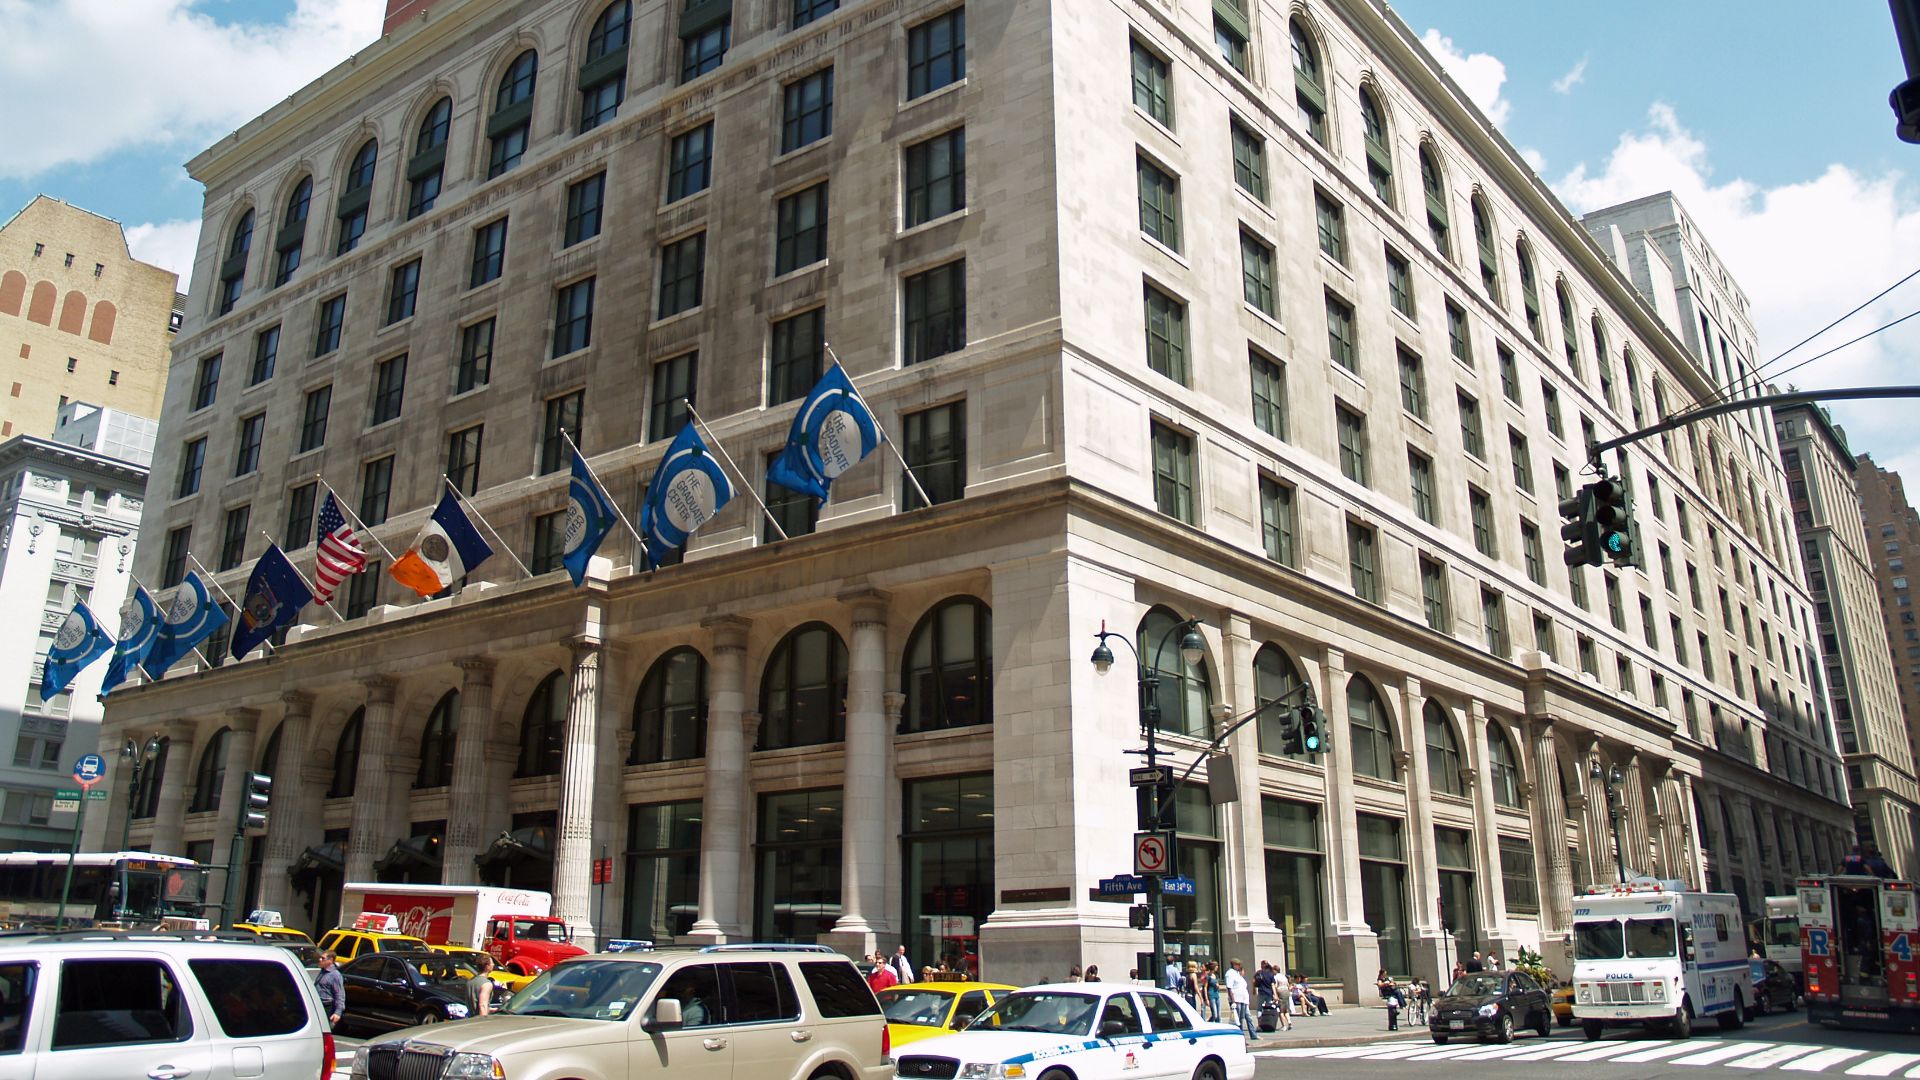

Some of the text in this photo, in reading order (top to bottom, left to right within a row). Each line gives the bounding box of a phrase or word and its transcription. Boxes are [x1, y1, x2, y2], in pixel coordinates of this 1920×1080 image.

[833, 413, 846, 434] THE
[825, 421, 850, 471] GRADUATE
[686, 471, 701, 491] THE
[668, 489, 690, 522] CENTER
[677, 480, 705, 526] GRADUATE
[1104, 882, 1142, 892] Fifth Ave
[1164, 881, 1193, 893] East 34th St
[1655, 904, 1672, 912] NYPD
[1692, 912, 1716, 929] POLICE
[1808, 928, 1913, 962] R 4
[1605, 972, 1634, 980] POLICE
